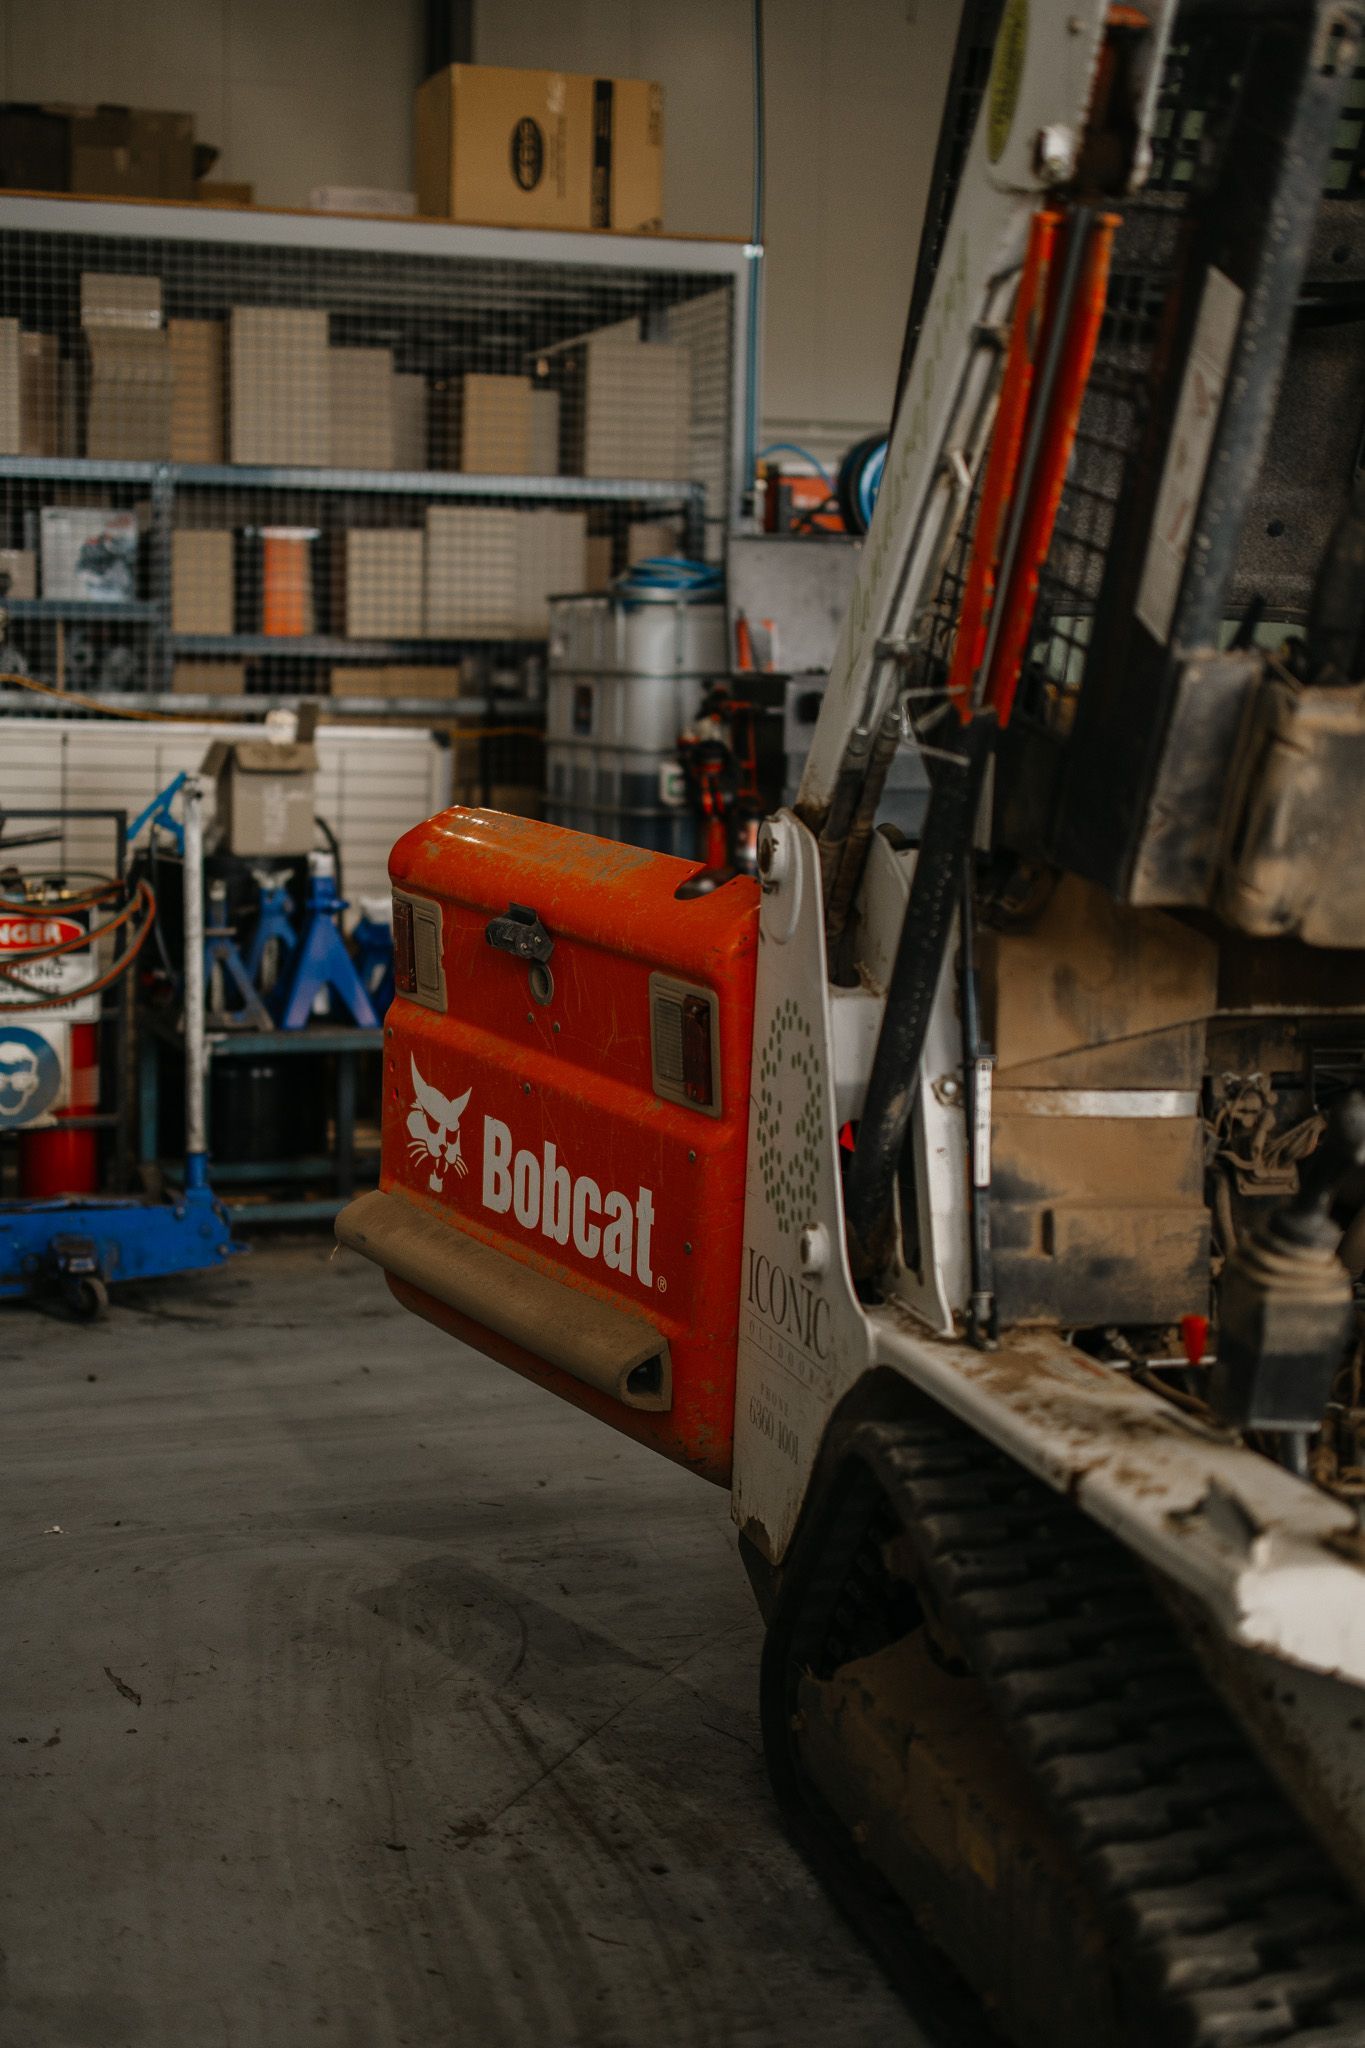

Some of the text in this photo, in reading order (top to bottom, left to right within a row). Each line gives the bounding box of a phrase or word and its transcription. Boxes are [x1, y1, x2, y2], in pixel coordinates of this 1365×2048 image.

[483, 1114, 654, 1287] Bobcat
[748, 1247, 831, 1360] ICONIC
[750, 1396, 774, 1440] 6360
